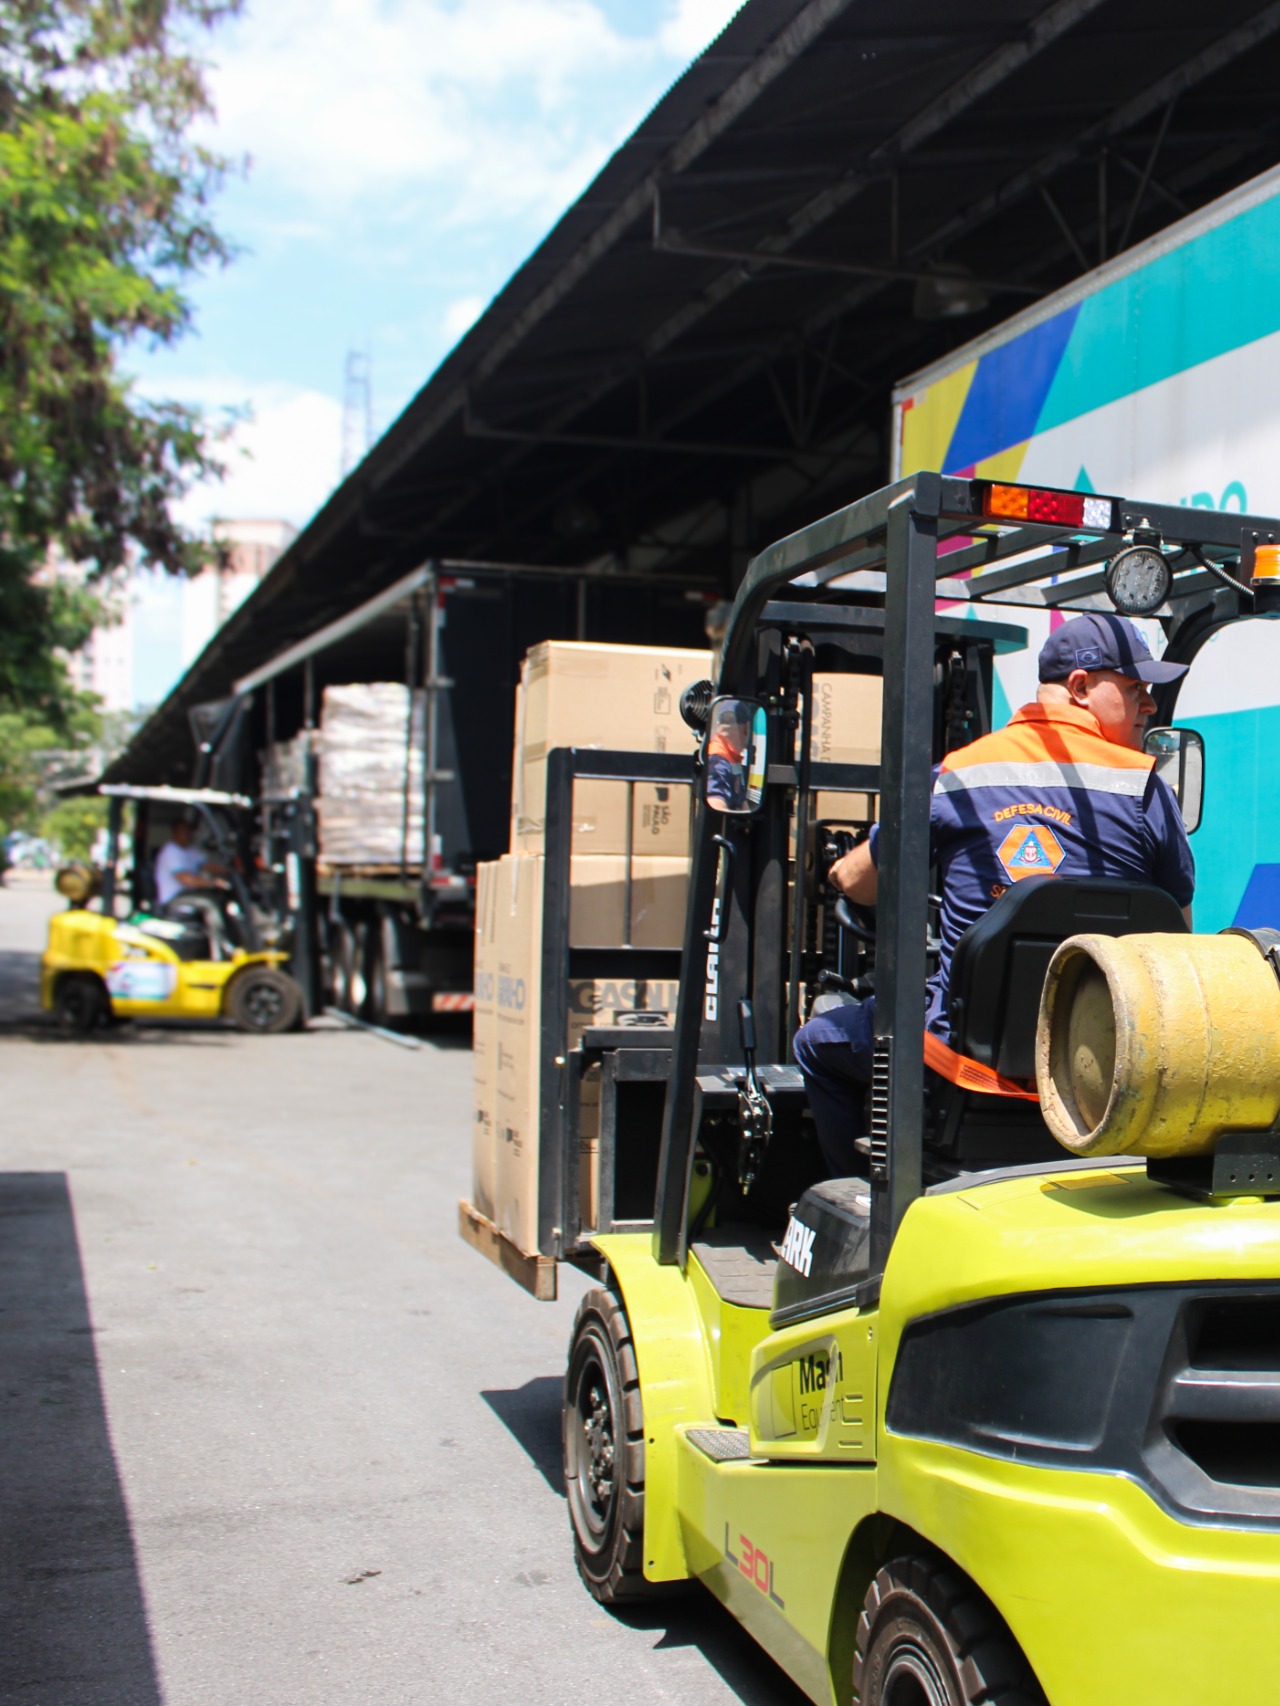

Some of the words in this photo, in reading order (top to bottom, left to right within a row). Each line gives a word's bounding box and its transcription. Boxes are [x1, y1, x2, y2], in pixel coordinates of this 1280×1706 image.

[994, 803, 1043, 822] DEFESA
[1043, 806, 1072, 826] CIVIL
[780, 1215, 817, 1278] ARK
[725, 1521, 785, 1610] L30L
